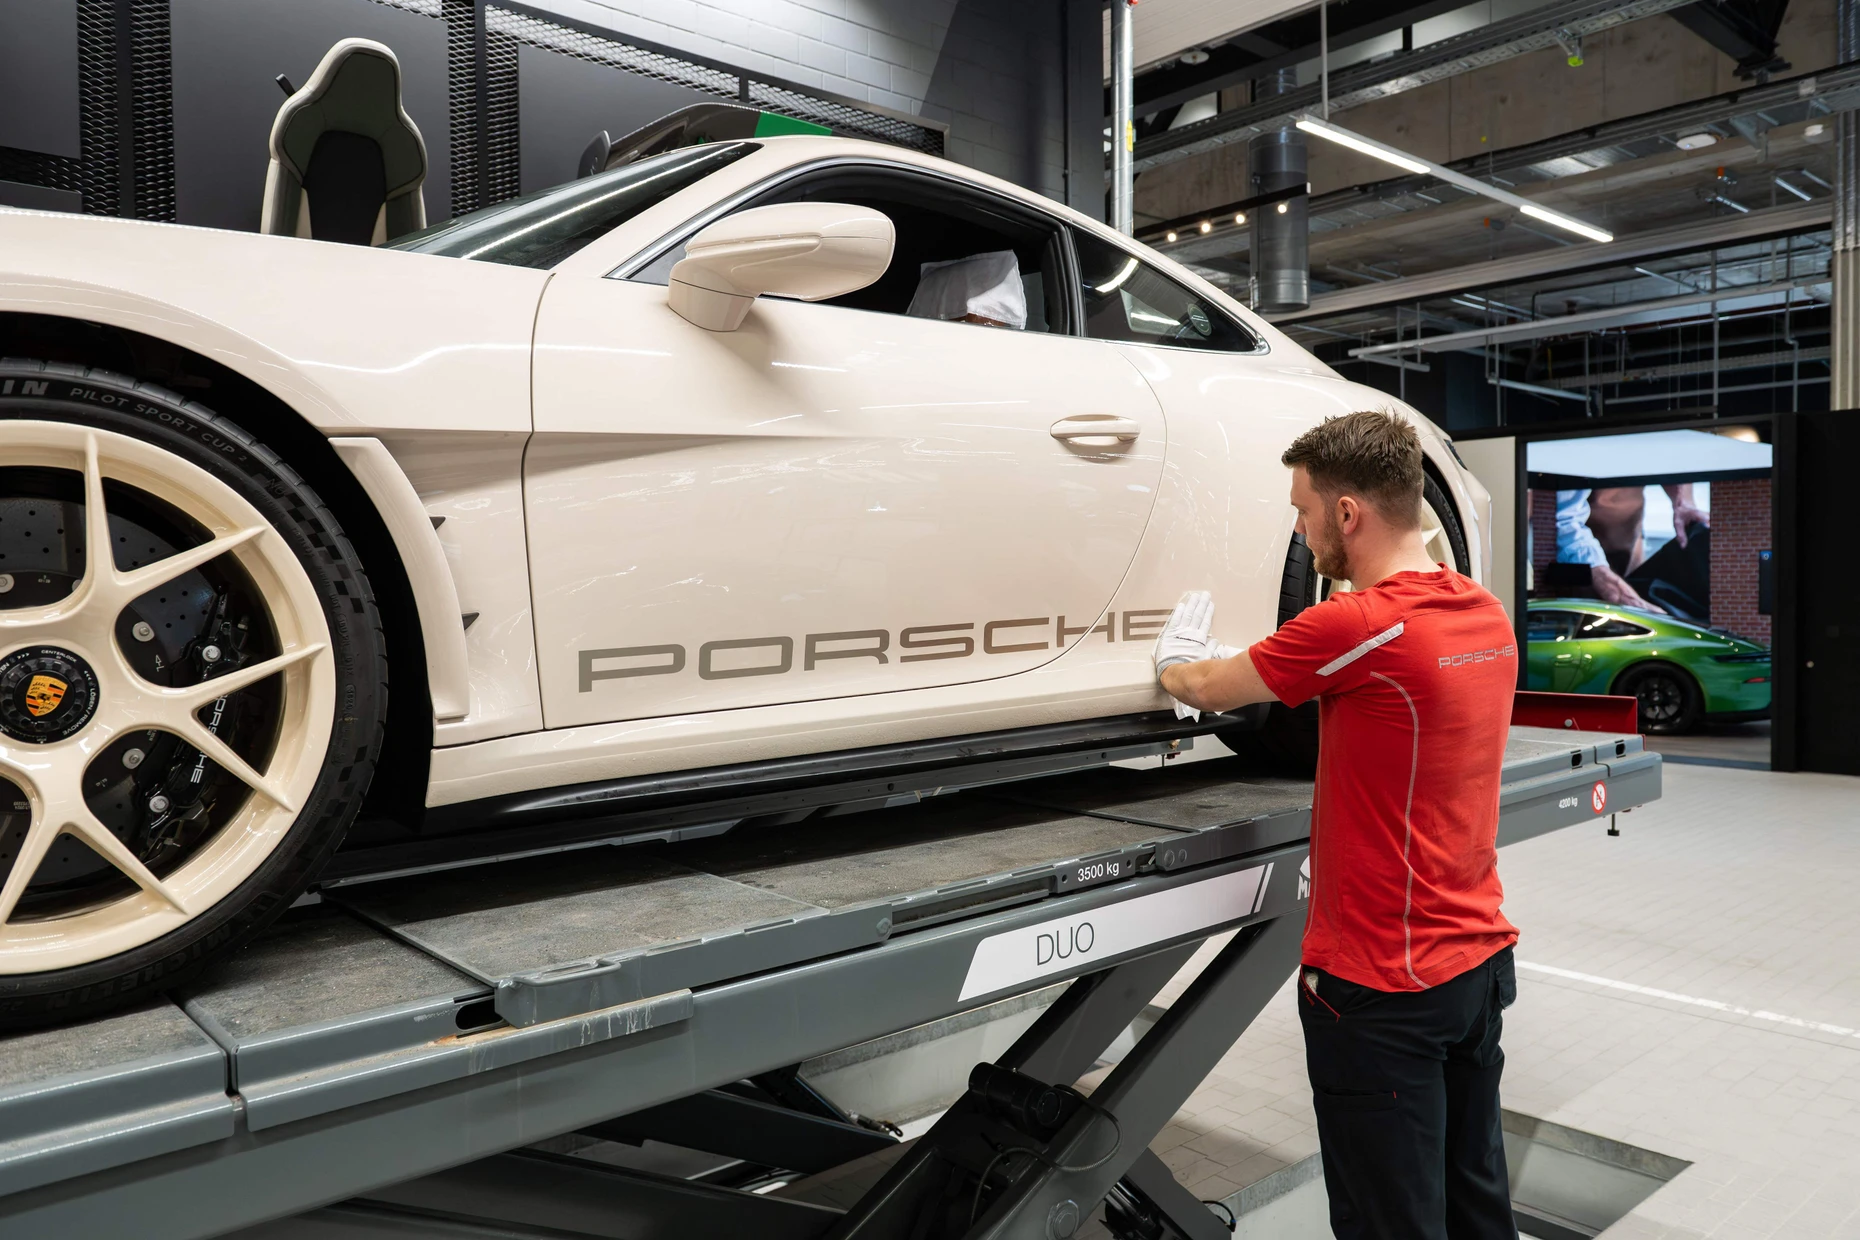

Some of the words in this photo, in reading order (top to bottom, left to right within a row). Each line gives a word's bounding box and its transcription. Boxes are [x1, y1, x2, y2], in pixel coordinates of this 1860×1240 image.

[70, 387, 129, 406] PILOT
[134, 403, 198, 432] SPORT
[201, 432, 236, 453] CUP
[41, 649, 77, 662] CENTERLOCK
[578, 608, 1174, 693] PORSCHE
[1438, 645, 1514, 669] PORSCHE
[62, 714, 88, 736] REMOVE
[1571, 796, 1578, 807] kg
[1077, 863, 1103, 882] 3500
[1106, 861, 1119, 876] kg
[1036, 922, 1095, 966] DUO
